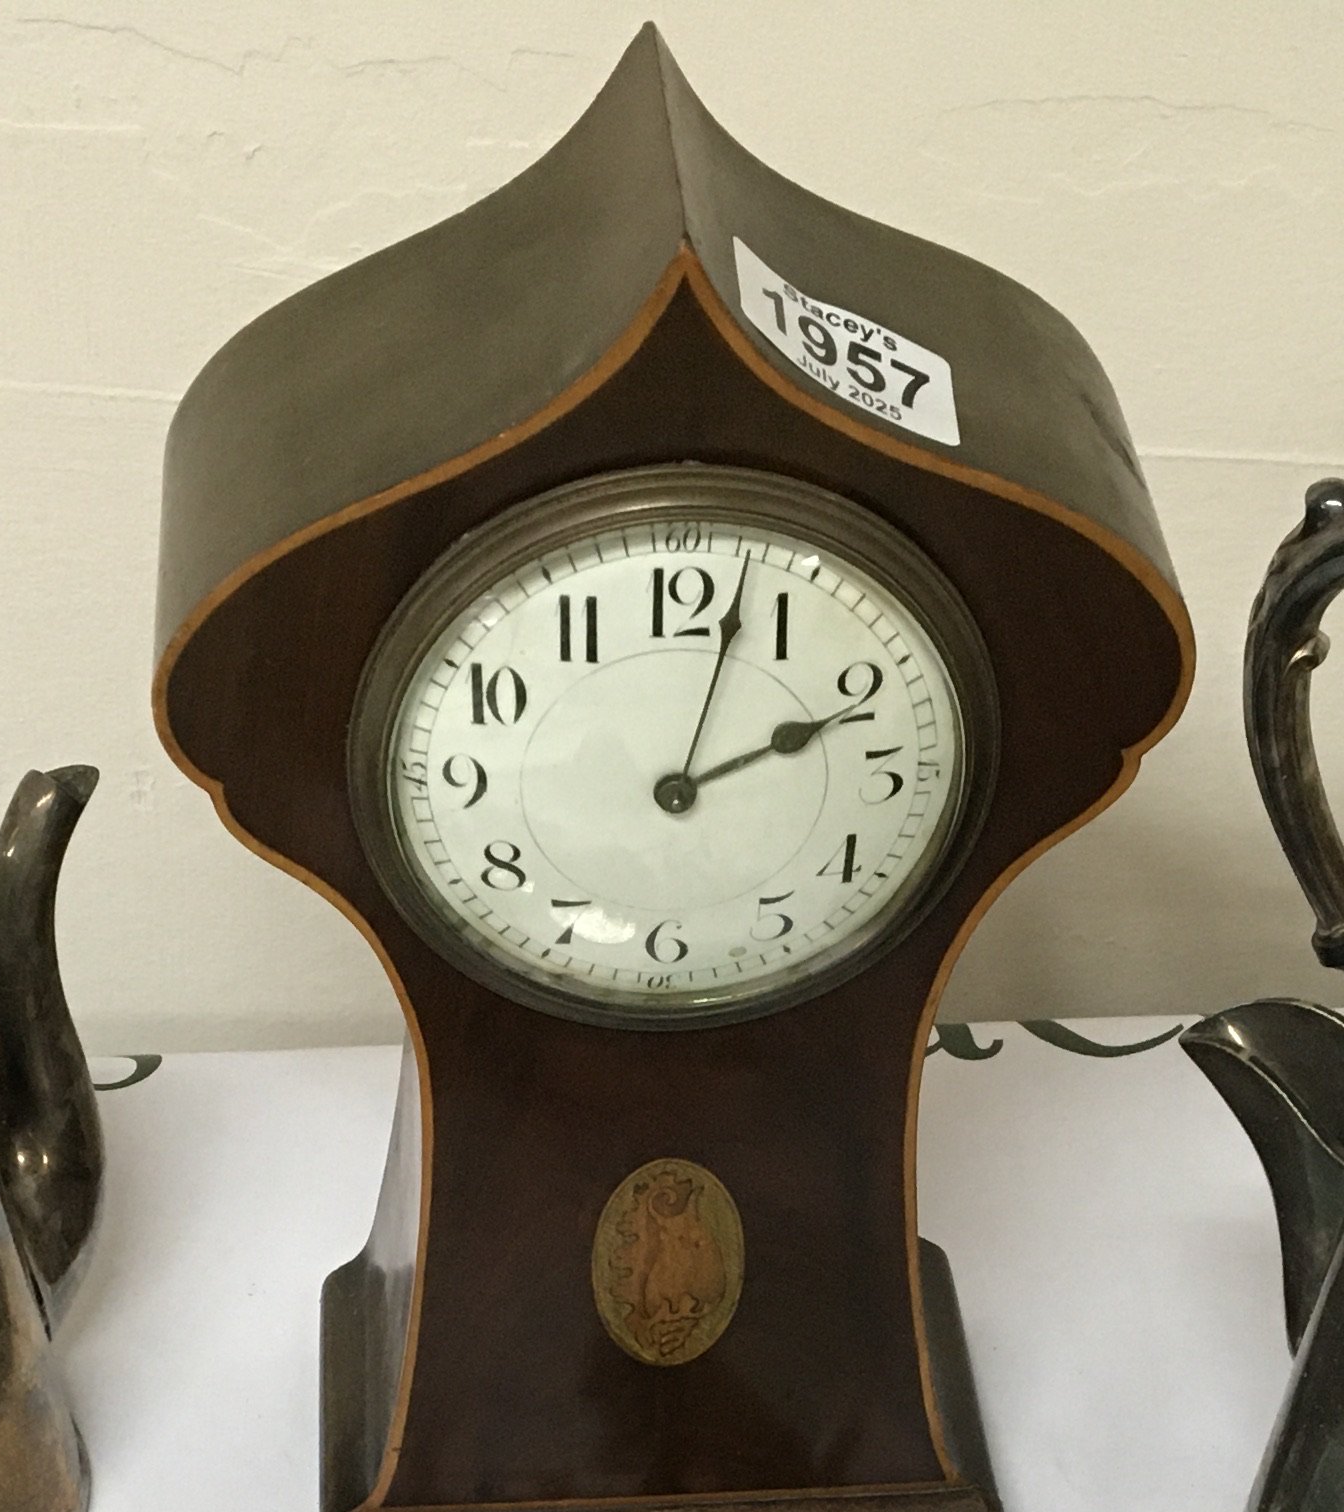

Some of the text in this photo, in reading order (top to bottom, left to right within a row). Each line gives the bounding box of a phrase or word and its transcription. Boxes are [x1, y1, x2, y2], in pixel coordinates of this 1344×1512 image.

[762, 286, 930, 409] 1957
[783, 282, 897, 352] Stacey's
[796, 356, 902, 421] July 2025
[557, 593, 599, 663] 11
[647, 566, 715, 638] 12
[771, 592, 789, 661] 1
[470, 661, 528, 726] 10
[836, 661, 884, 725] 2
[441, 754, 488, 810] 9
[858, 745, 904, 805] 3
[480, 839, 527, 890] 8
[815, 833, 862, 885] 4
[550, 898, 592, 945] 7
[644, 918, 689, 964] 6
[749, 889, 794, 940] 5
